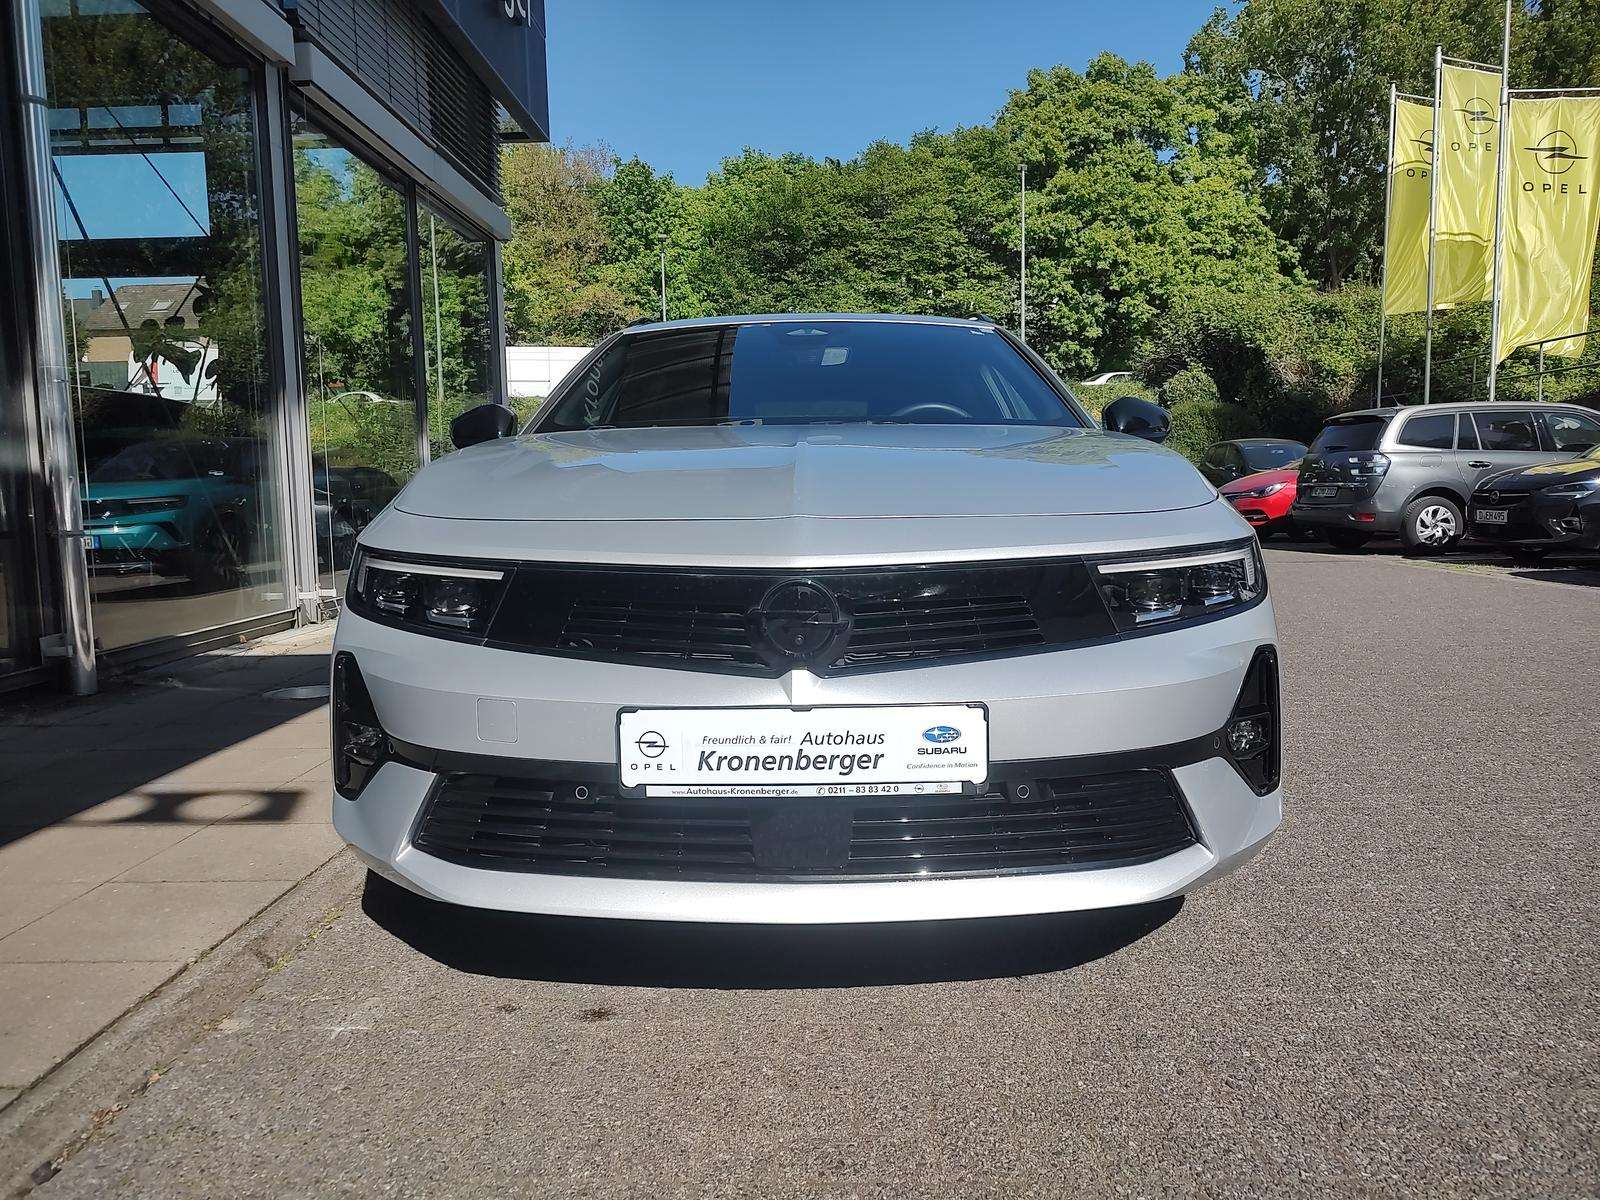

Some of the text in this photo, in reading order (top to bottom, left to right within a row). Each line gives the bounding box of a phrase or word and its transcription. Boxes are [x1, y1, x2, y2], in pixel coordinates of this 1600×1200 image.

[1451, 141, 1493, 152] OPE
[1406, 168, 1429, 179] OP
[1522, 181, 1588, 194] OPEL
[702, 730, 885, 745] Freundlich & fair! Autohaus
[917, 746, 968, 755] SUBARU
[630, 763, 676, 771] OPEL
[697, 749, 885, 775] Kronenberger
[827, 786, 846, 795] 0211
[855, 785, 867, 794] 83
[868, 785, 879, 794] 83
[880, 785, 892, 794] 42
